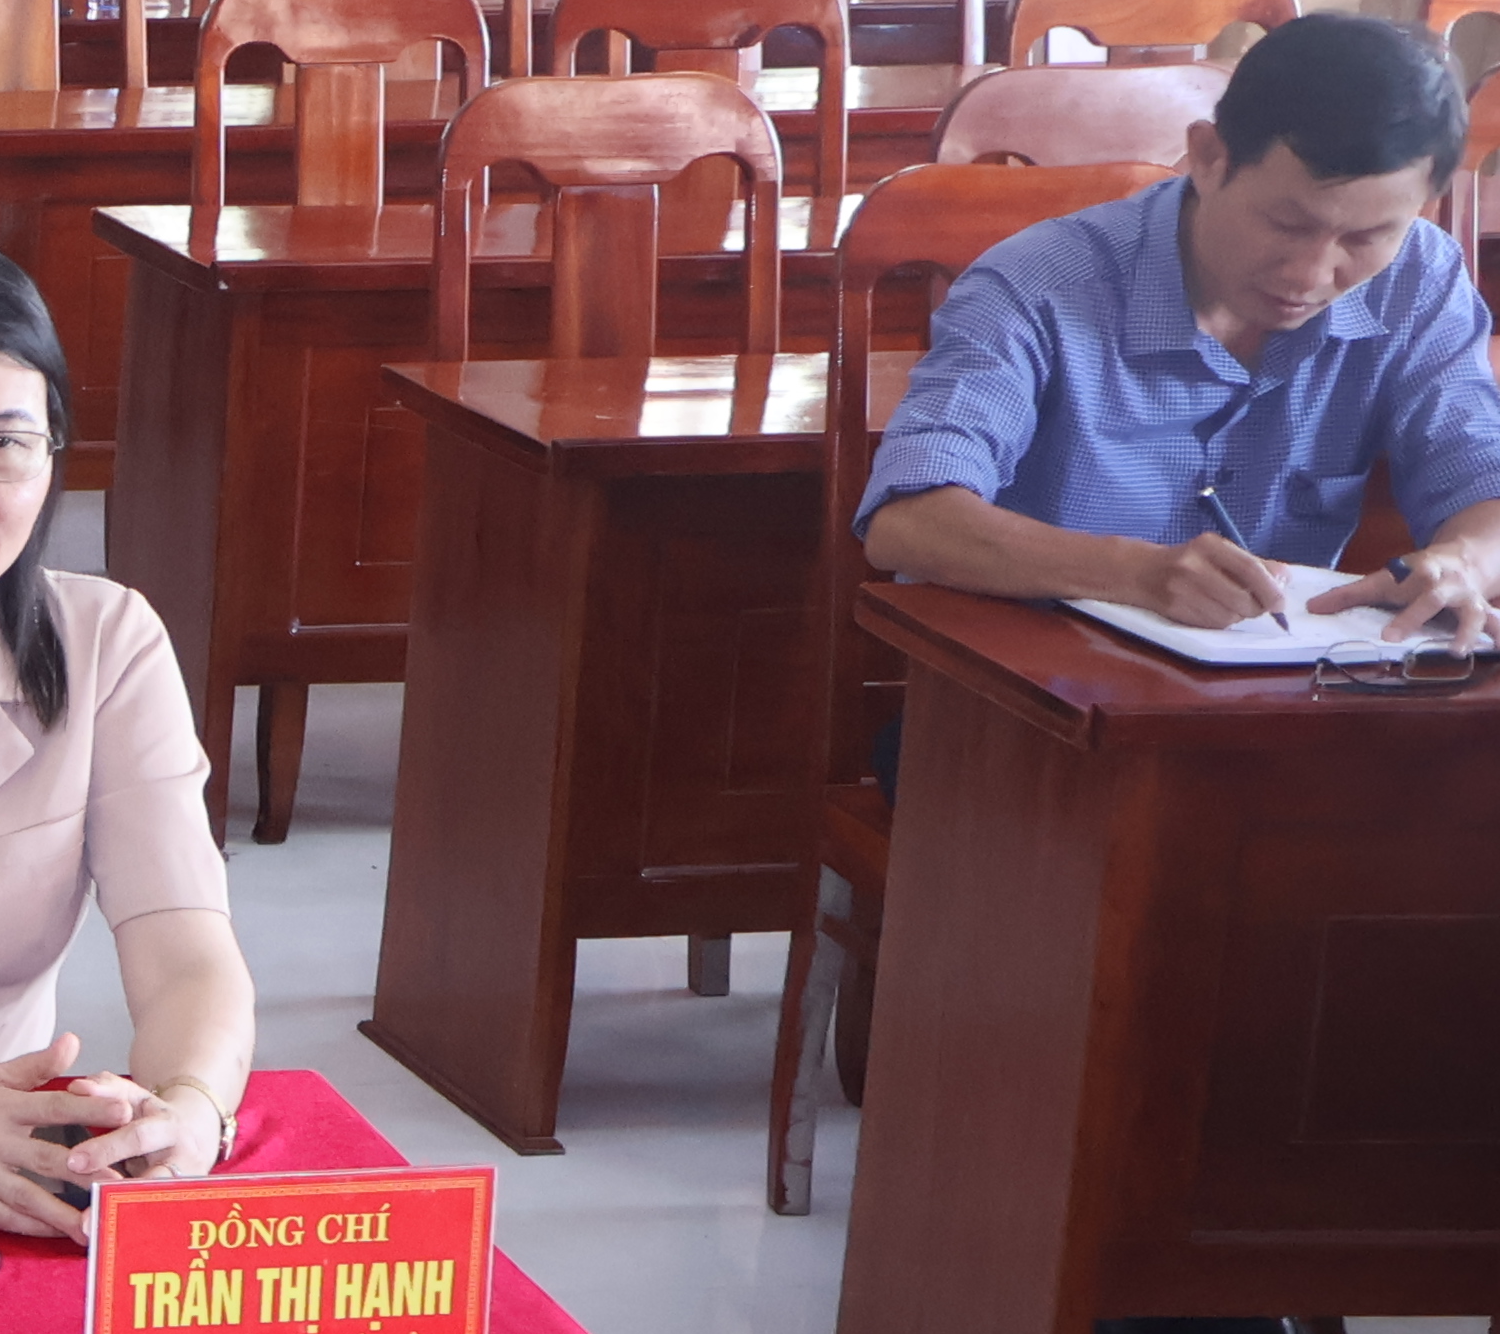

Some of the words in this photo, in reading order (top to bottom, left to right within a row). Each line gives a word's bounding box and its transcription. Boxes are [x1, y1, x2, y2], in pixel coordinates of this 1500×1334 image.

[187, 1202, 305, 1250] ĐỒNG
[317, 1203, 391, 1244] CHÍ
[129, 1248, 243, 1329] TRẦN
[256, 1265, 322, 1334] THỊ
[333, 1259, 455, 1331] HẠNH
